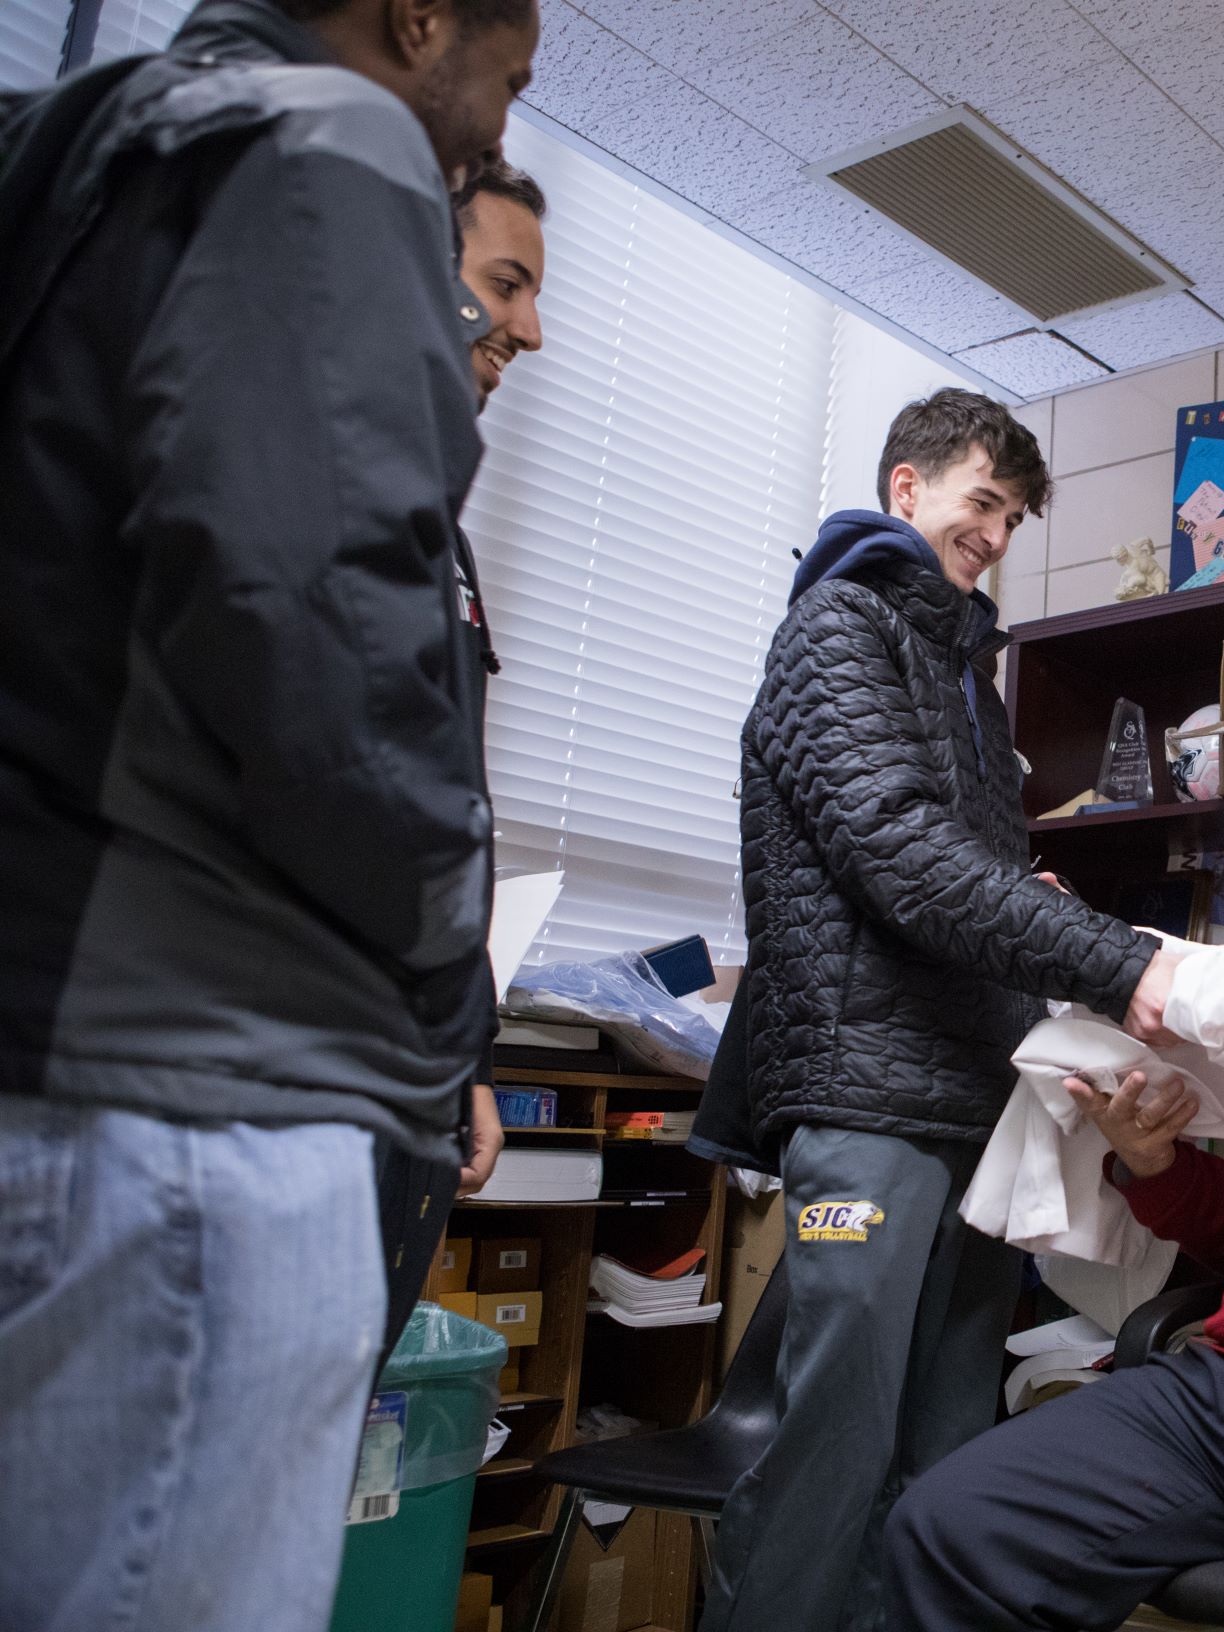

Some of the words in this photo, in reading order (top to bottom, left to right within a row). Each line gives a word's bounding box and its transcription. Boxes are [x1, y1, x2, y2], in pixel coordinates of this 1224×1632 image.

[1111, 774, 1141, 782] Chemistry
[802, 1207, 853, 1228] SJC
[746, 1264, 759, 1273] Box
